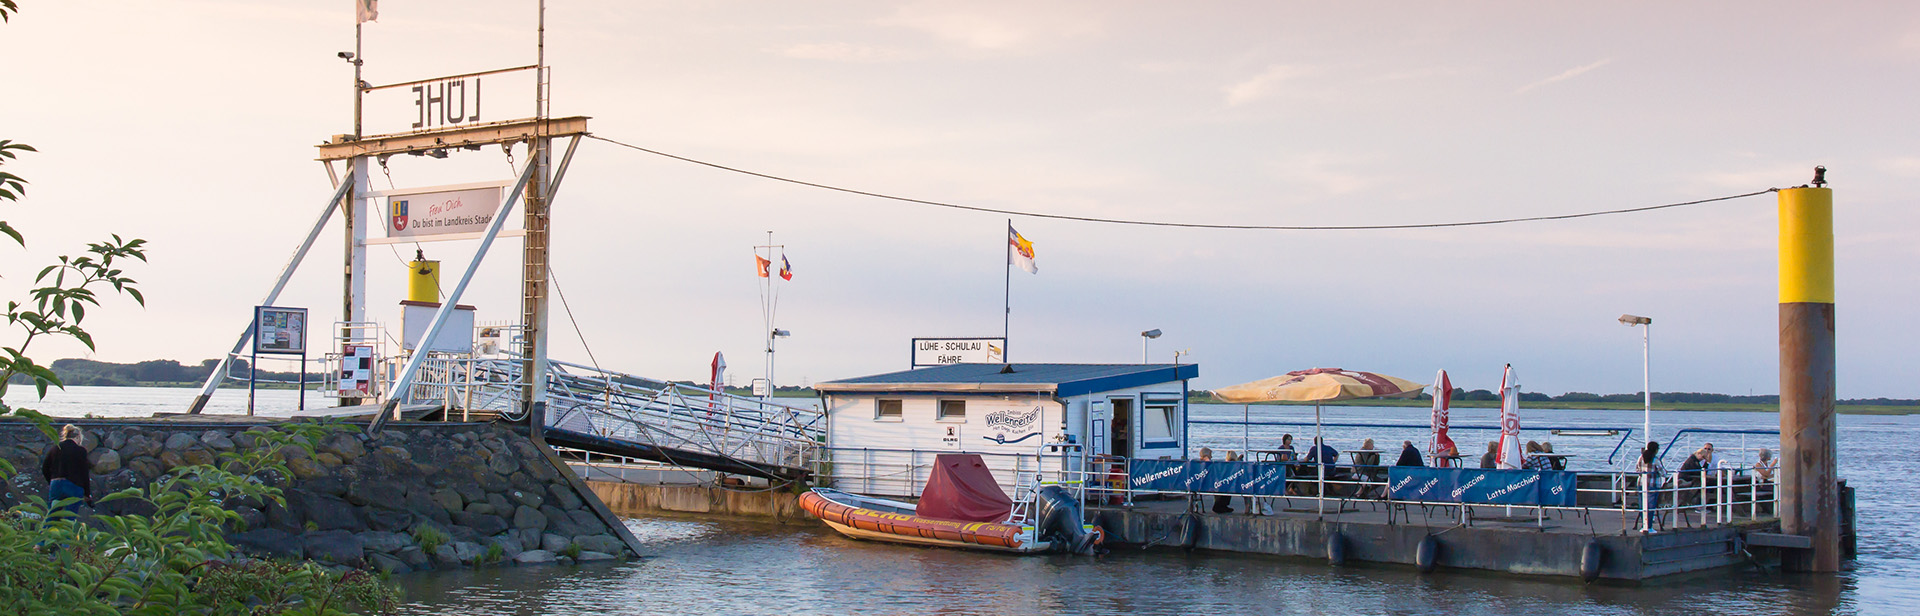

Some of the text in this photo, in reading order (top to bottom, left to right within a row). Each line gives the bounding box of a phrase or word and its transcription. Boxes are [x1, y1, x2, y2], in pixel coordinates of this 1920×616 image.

[445, 196, 463, 211] Dich
[412, 219, 421, 228] Du
[422, 218, 434, 228] bist
[435, 217, 443, 227] im
[444, 215, 473, 227] Landkreis
[919, 341, 939, 351] LÜHE
[945, 342, 982, 351] SCHULAU
[937, 354, 962, 363] FÄHRE
[985, 406, 1040, 428] Wellenreiter
[1132, 465, 1183, 487] Wellenreiter
[1213, 468, 1245, 489] Currywurst
[1260, 467, 1277, 480] Light
[1390, 475, 1413, 494] Kuchen
[1418, 477, 1439, 496] Kaffee
[1451, 474, 1485, 498] Cappuccino
[1486, 474, 1540, 501] Latte Macchiato
[1550, 484, 1563, 495] Eis
[913, 517, 961, 529] Wasserrettung
